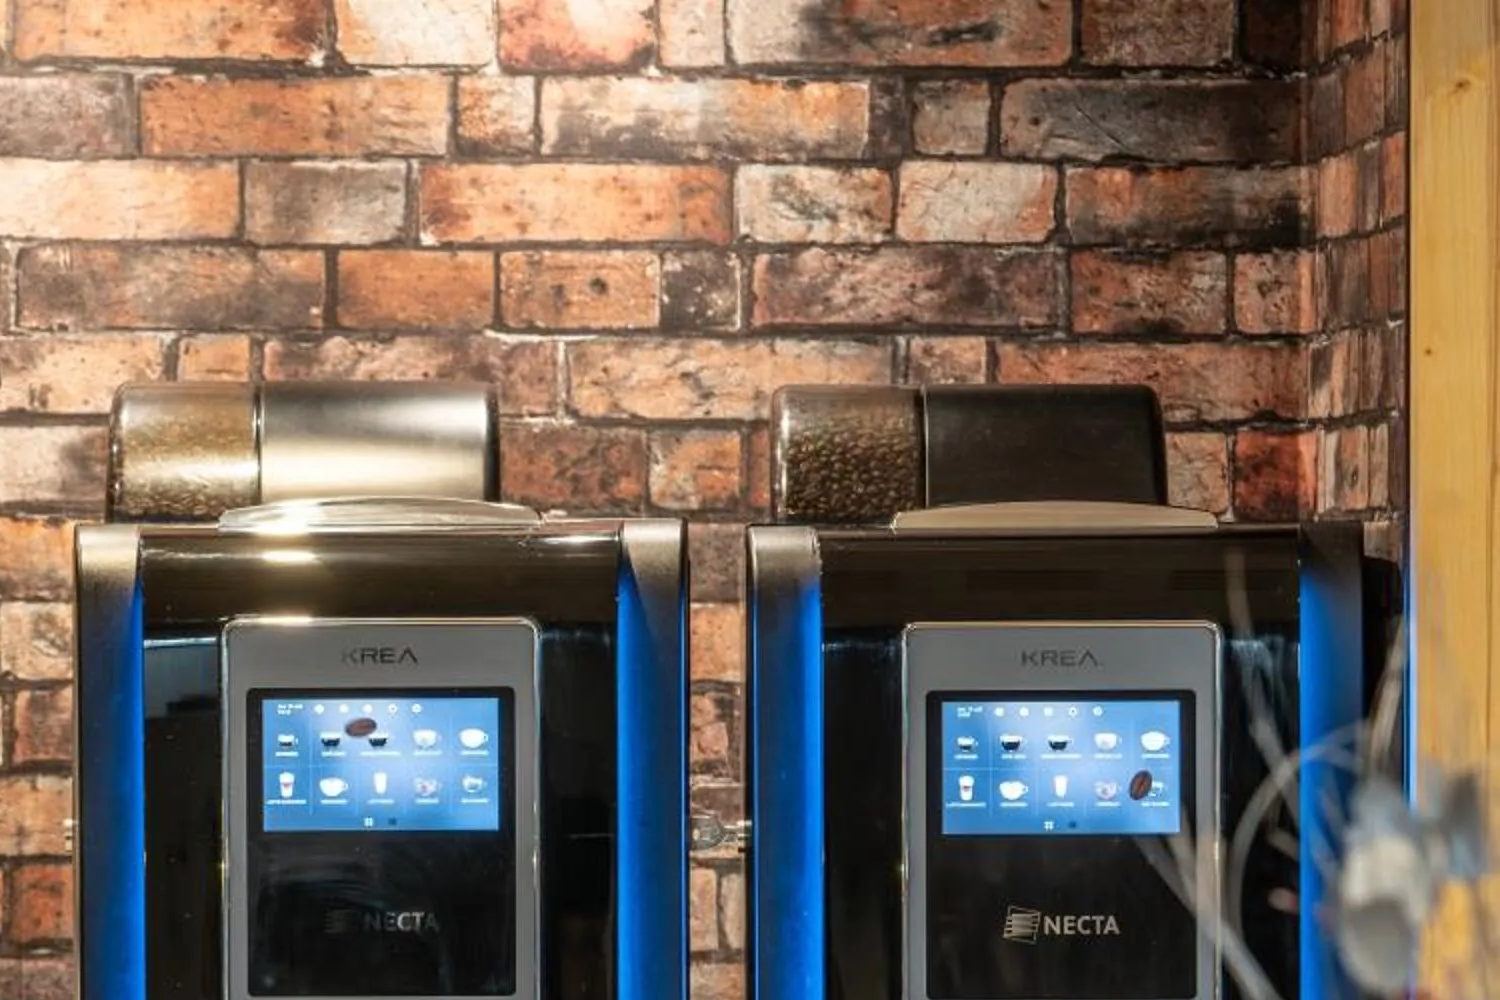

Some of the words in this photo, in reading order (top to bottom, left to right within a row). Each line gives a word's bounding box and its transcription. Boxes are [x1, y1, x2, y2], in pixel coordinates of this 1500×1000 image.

[341, 647, 419, 665] KREA
[1020, 649, 1099, 667] KREA
[363, 911, 440, 932] NECTA
[1043, 915, 1121, 936] NECTA
